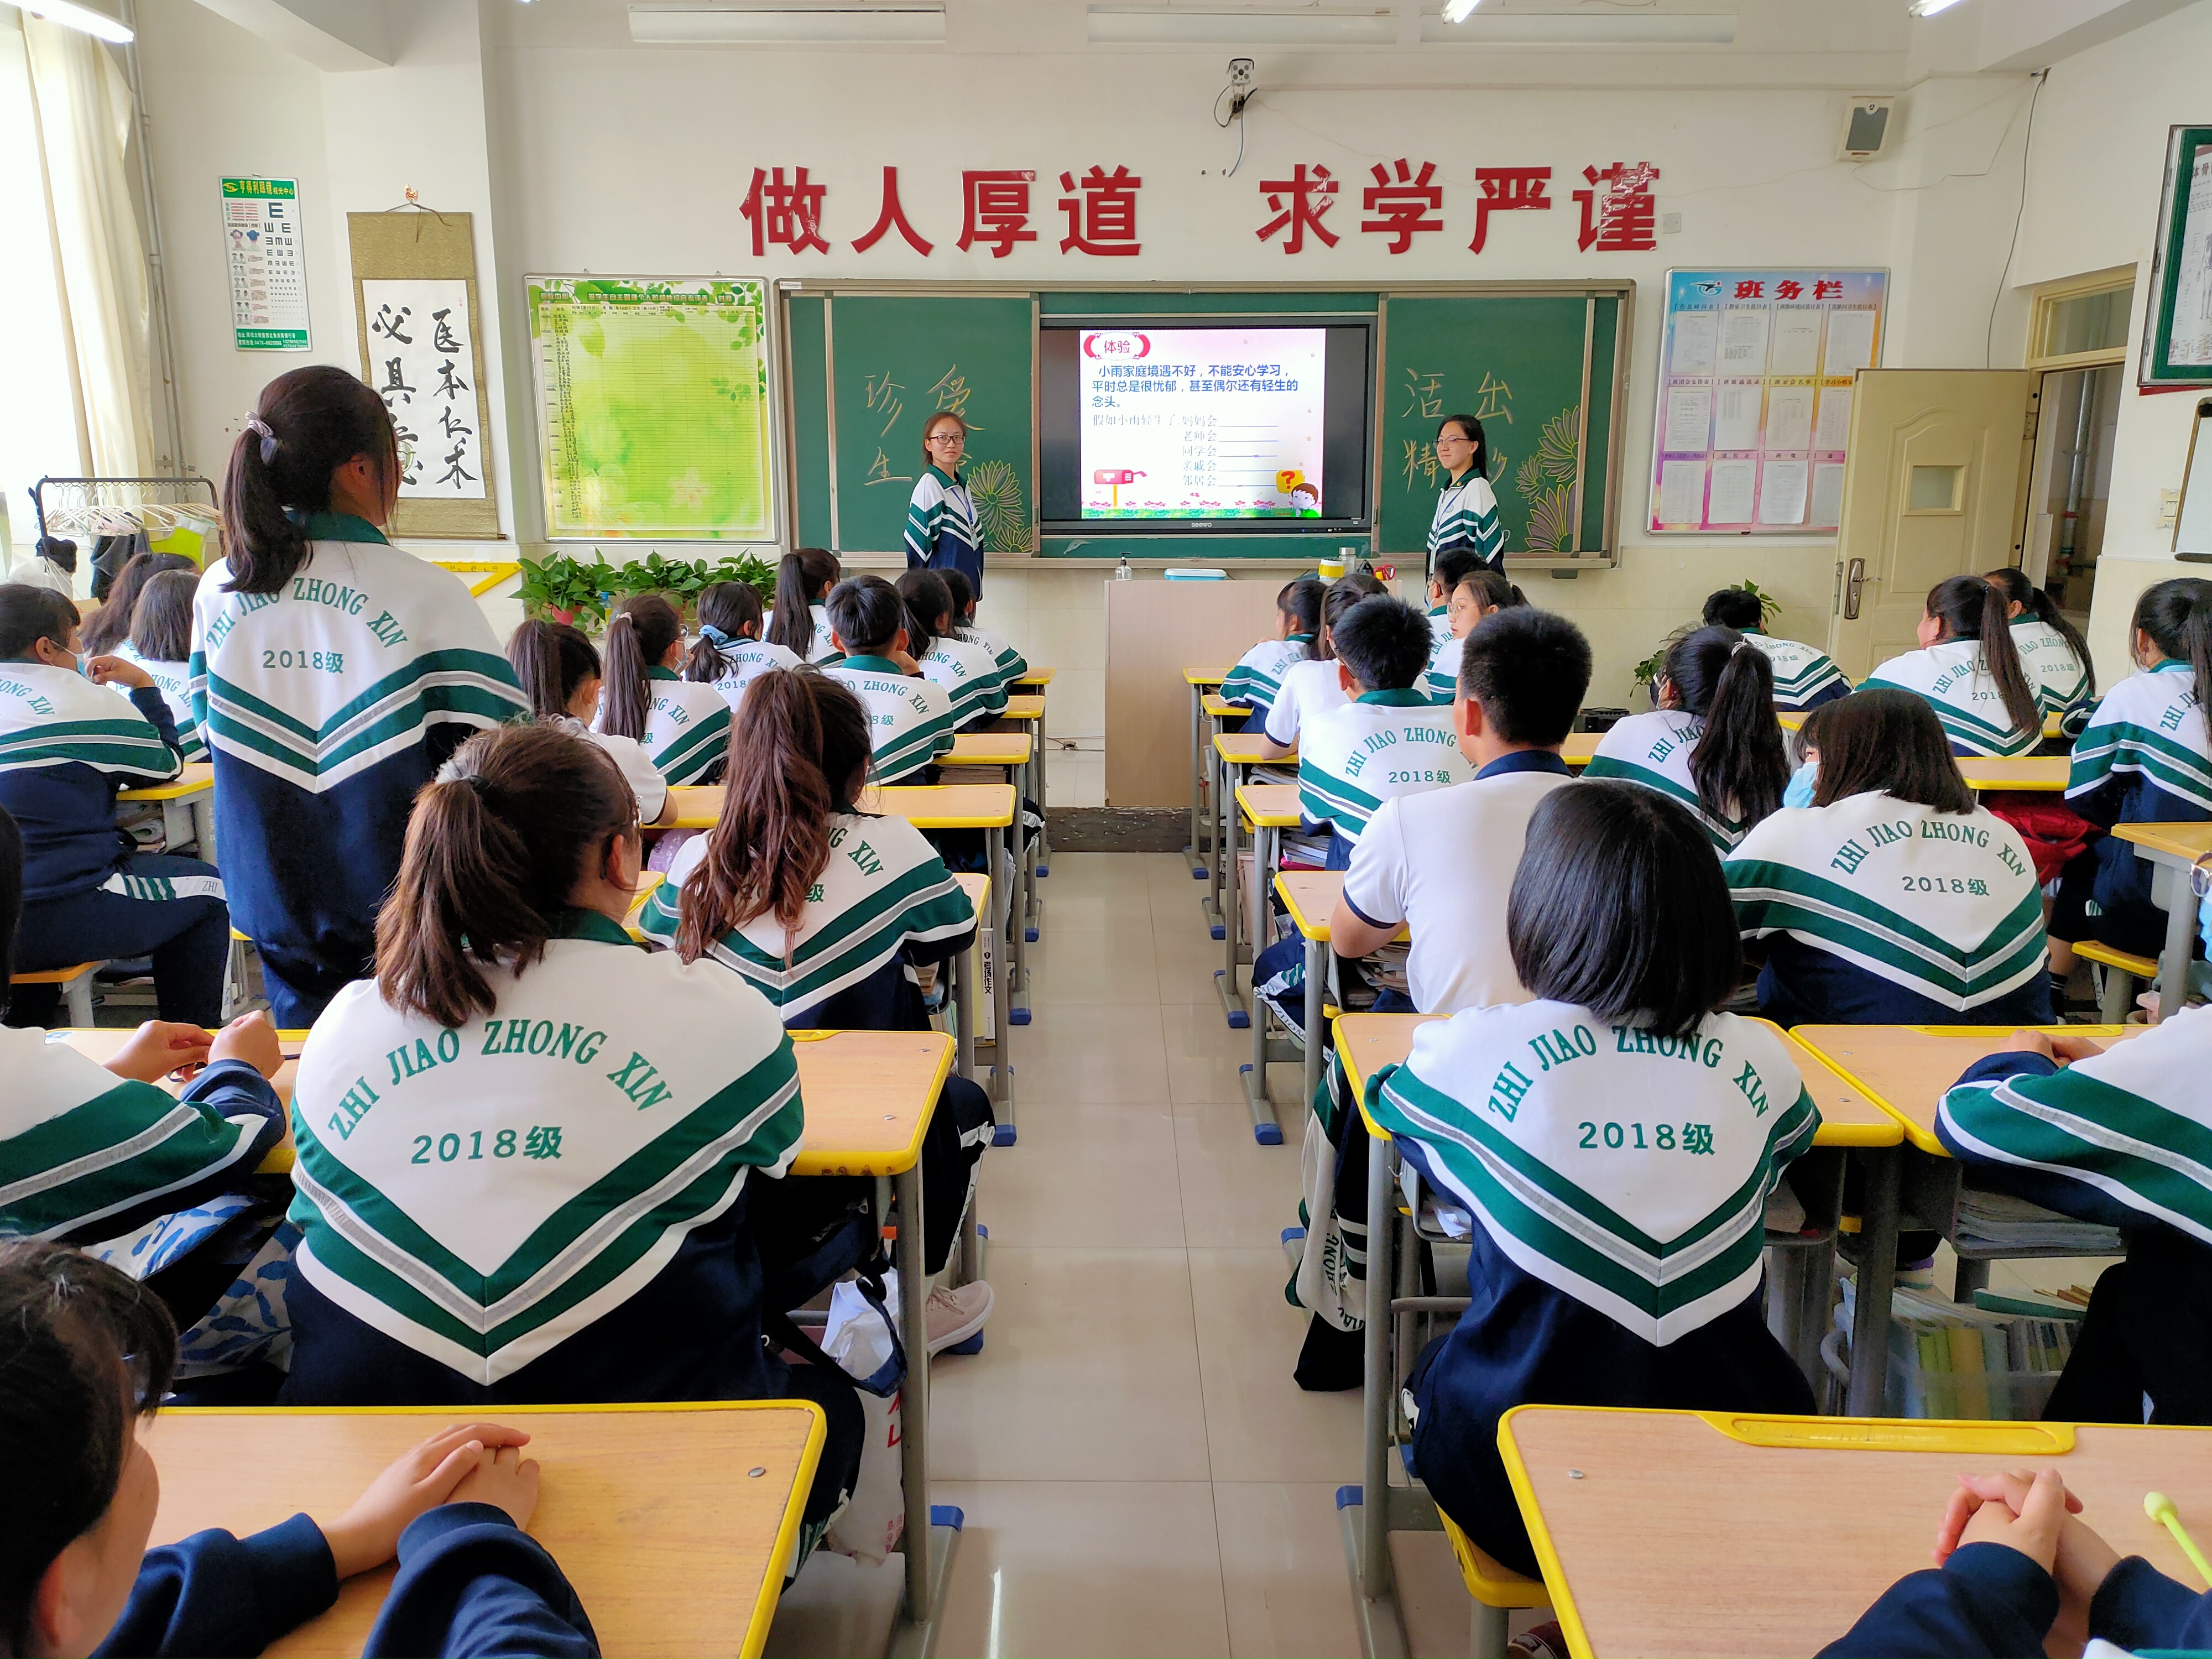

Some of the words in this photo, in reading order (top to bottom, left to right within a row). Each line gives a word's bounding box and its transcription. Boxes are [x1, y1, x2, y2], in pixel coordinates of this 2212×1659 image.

[739, 165, 1141, 258] 做人厚道
[1255, 158, 1660, 255] 求学严谨
[1734, 280, 1844, 300] 班务栏
[1104, 340, 1130, 353] 体验
[1401, 368, 1514, 425] 活出
[1184, 430, 1217, 442] 老师会
[1182, 445, 1217, 457] 同学会
[206, 609, 236, 649] ZHI
[293, 577, 369, 615] ZHONG
[366, 610, 408, 648] XIN
[957, 633, 980, 645] HONG
[983, 641, 993, 655] XIN
[1441, 632, 1454, 643] JIA
[2018, 640, 2038, 654] JIAO
[263, 650, 343, 674] 2018级
[922, 651, 950, 664] HONG
[950, 660, 967, 677] XIN
[1271, 658, 1287, 675] ZHI
[717, 679, 750, 691] 2018
[1932, 674, 1954, 694] ZHI
[1950, 660, 1975, 678] JIAO
[0, 678, 33, 697] ONG
[27, 696, 55, 715] XIN
[863, 680, 909, 696] ZHONG
[909, 693, 930, 714] XIN
[668, 705, 690, 726] XIN
[2159, 705, 2185, 731] ZHI
[1345, 750, 1367, 778] ZHI
[1363, 730, 1396, 753] JIAO
[1404, 727, 1457, 747] ZHONG
[1647, 737, 1676, 763] ZHI
[1388, 770, 1451, 784] 2018级
[847, 839, 884, 877] XIN
[1830, 838, 1870, 875] ZHI
[1865, 820, 1913, 848] JIAO
[1920, 818, 1990, 848] ZHONG
[1996, 842, 2027, 877] XIN
[201, 880, 218, 893] ZHI
[1902, 876, 1990, 896] 2018级
[1274, 1005, 1306, 1040] ZHON
[327, 1075, 380, 1141] ZHI
[385, 1027, 460, 1086] JIAO
[481, 1019, 607, 1065] ZHONG
[607, 1051, 673, 1112] XIN
[1488, 1061, 1533, 1123] ZHI
[1528, 1024, 1597, 1071] JIAO
[1611, 1025, 1724, 1068] ZHONG
[1733, 1060, 1770, 1118] XIN
[411, 1125, 563, 1165] 2018级
[1578, 1121, 1716, 1156] 2018级
